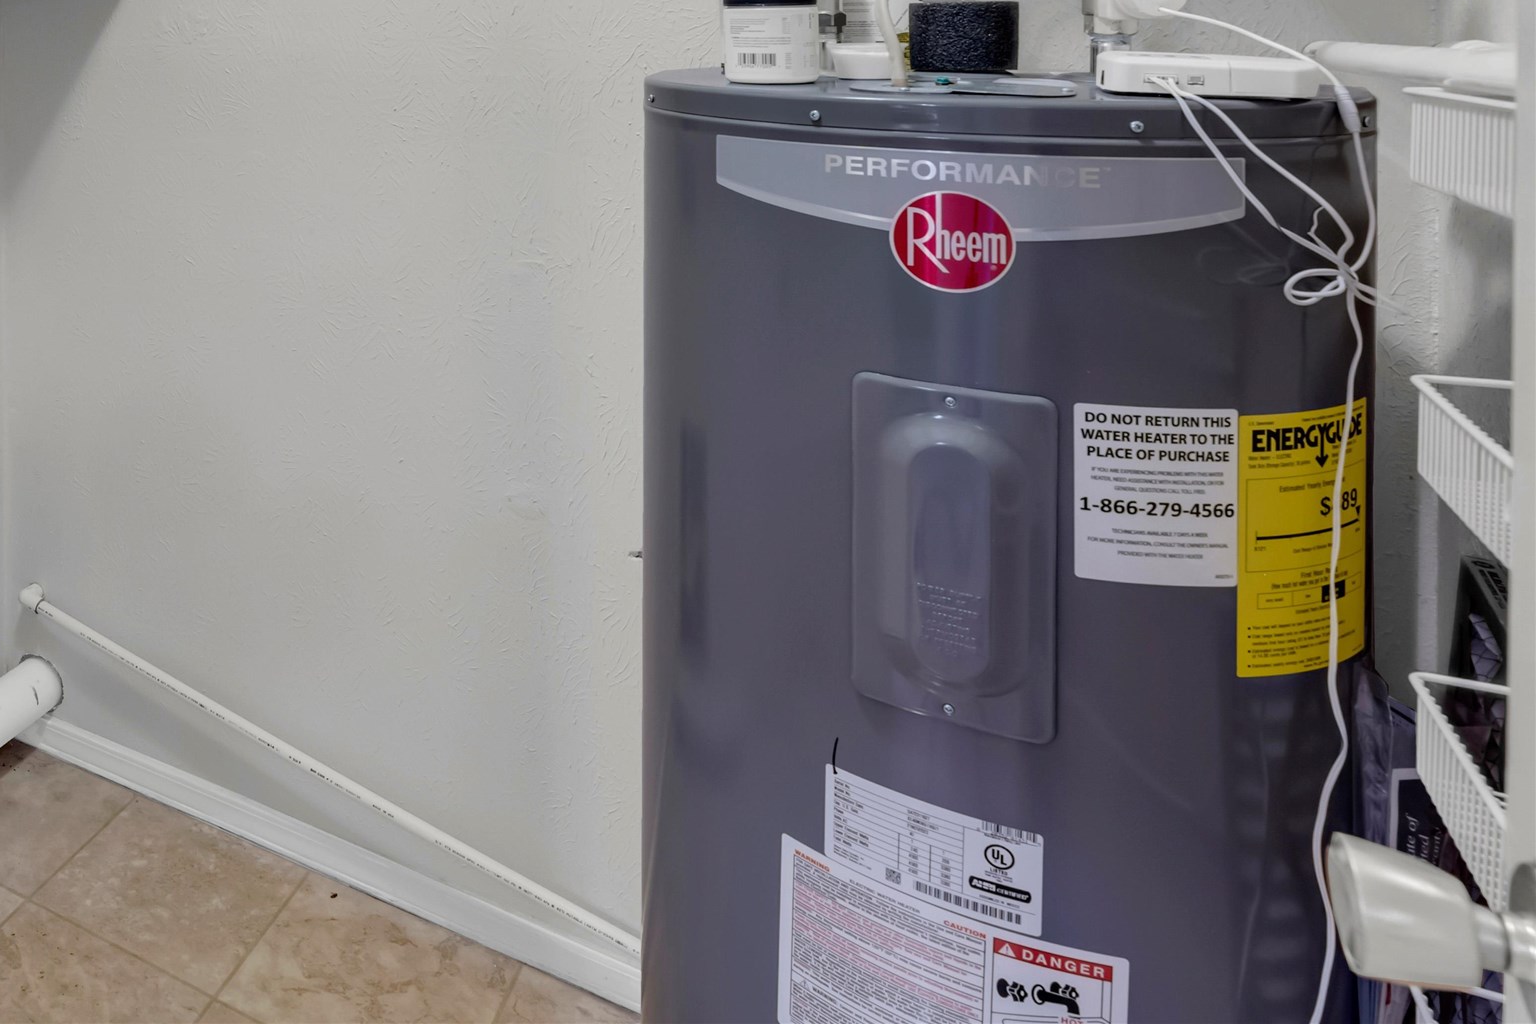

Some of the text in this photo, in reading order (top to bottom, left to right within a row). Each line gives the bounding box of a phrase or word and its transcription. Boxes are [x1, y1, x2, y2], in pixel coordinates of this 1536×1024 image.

[824, 153, 1101, 189] PERFORMANCE
[906, 191, 1007, 274] Rheem
[1084, 411, 1231, 428] DO NOT RETURN THIS
[1080, 428, 1234, 445] WATER HEATER TO THE
[1252, 412, 1362, 454] ENERGYGUDE
[1086, 445, 1230, 462] PLACE OF PURCHASE
[1079, 496, 1235, 518] 1-866-279-4566
[1320, 488, 1357, 516] $89
[794, 849, 831, 873] WARNING
[991, 848, 1008, 866] UL
[943, 919, 987, 939] CAUTION
[1021, 948, 1105, 979] DANGER
